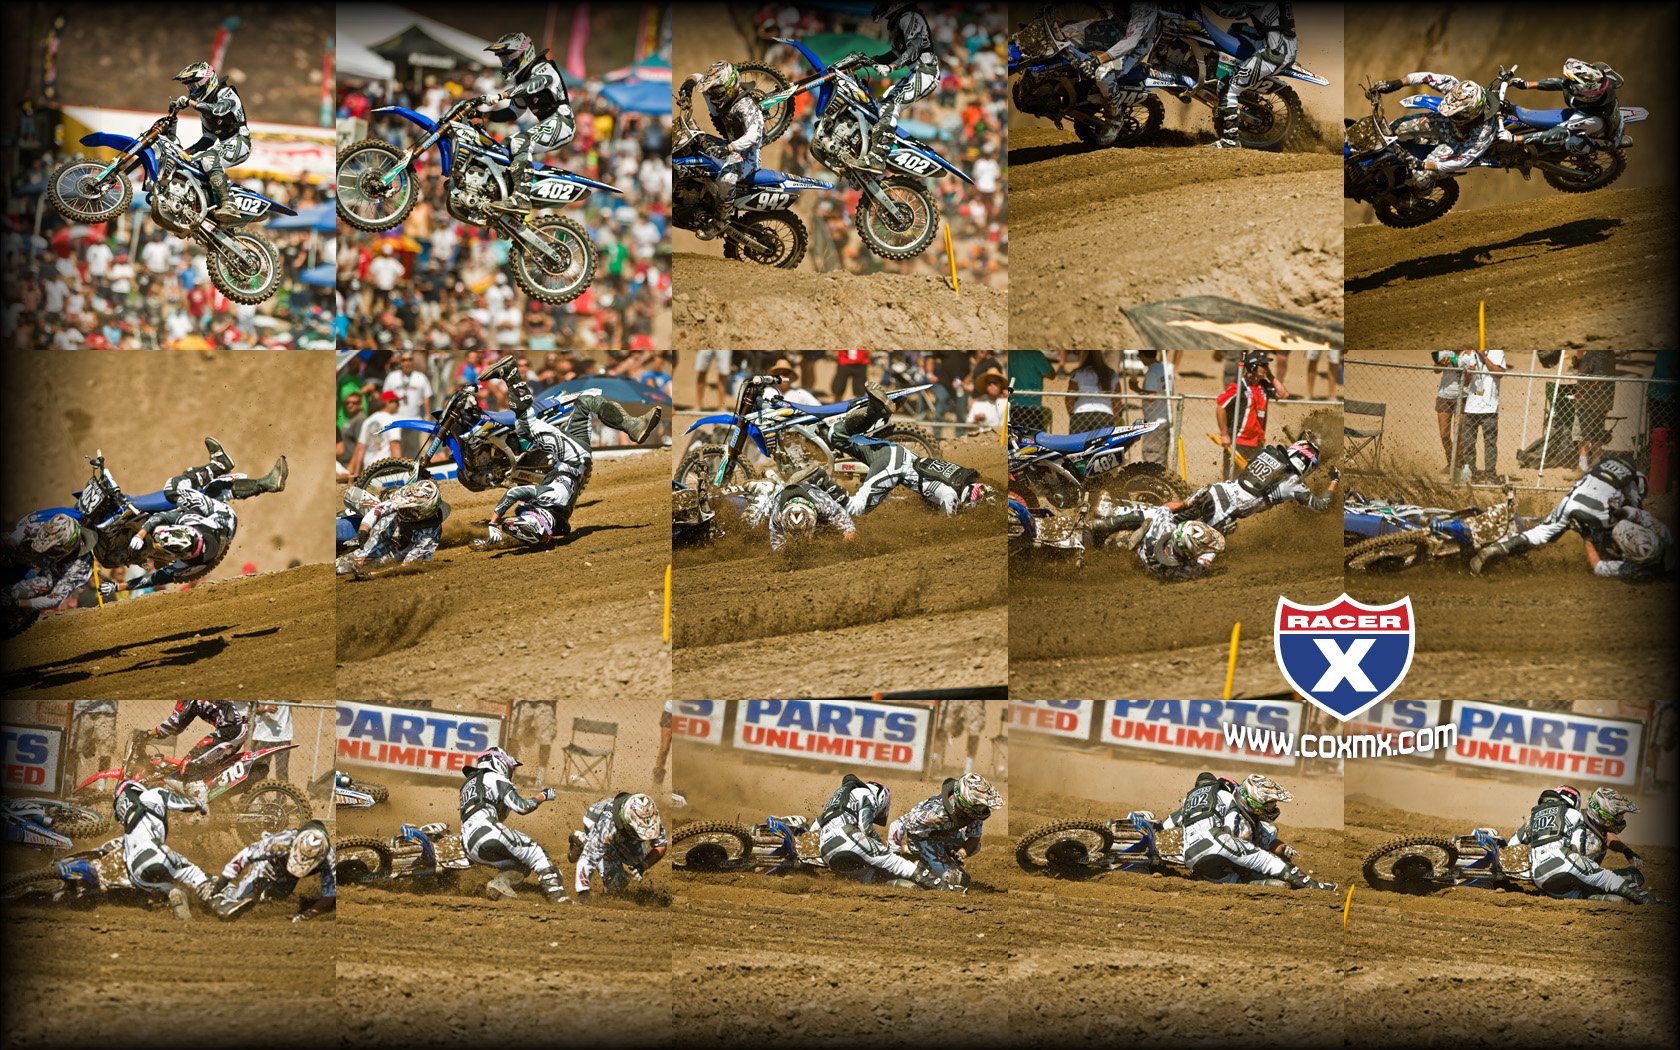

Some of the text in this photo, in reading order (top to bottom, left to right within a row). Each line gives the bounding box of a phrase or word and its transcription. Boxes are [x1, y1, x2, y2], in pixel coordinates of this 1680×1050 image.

[895, 152, 931, 174] 402
[537, 183, 575, 200] 402
[756, 192, 791, 211] 942
[1093, 453, 1119, 474] 402
[1248, 460, 1273, 482] 402
[745, 700, 917, 743] PARTS
[1459, 706, 1629, 757] PARTS
[741, 725, 913, 764] UNLIMITED
[1455, 738, 1626, 778] UNLIMITED
[1533, 813, 1557, 832] 402
